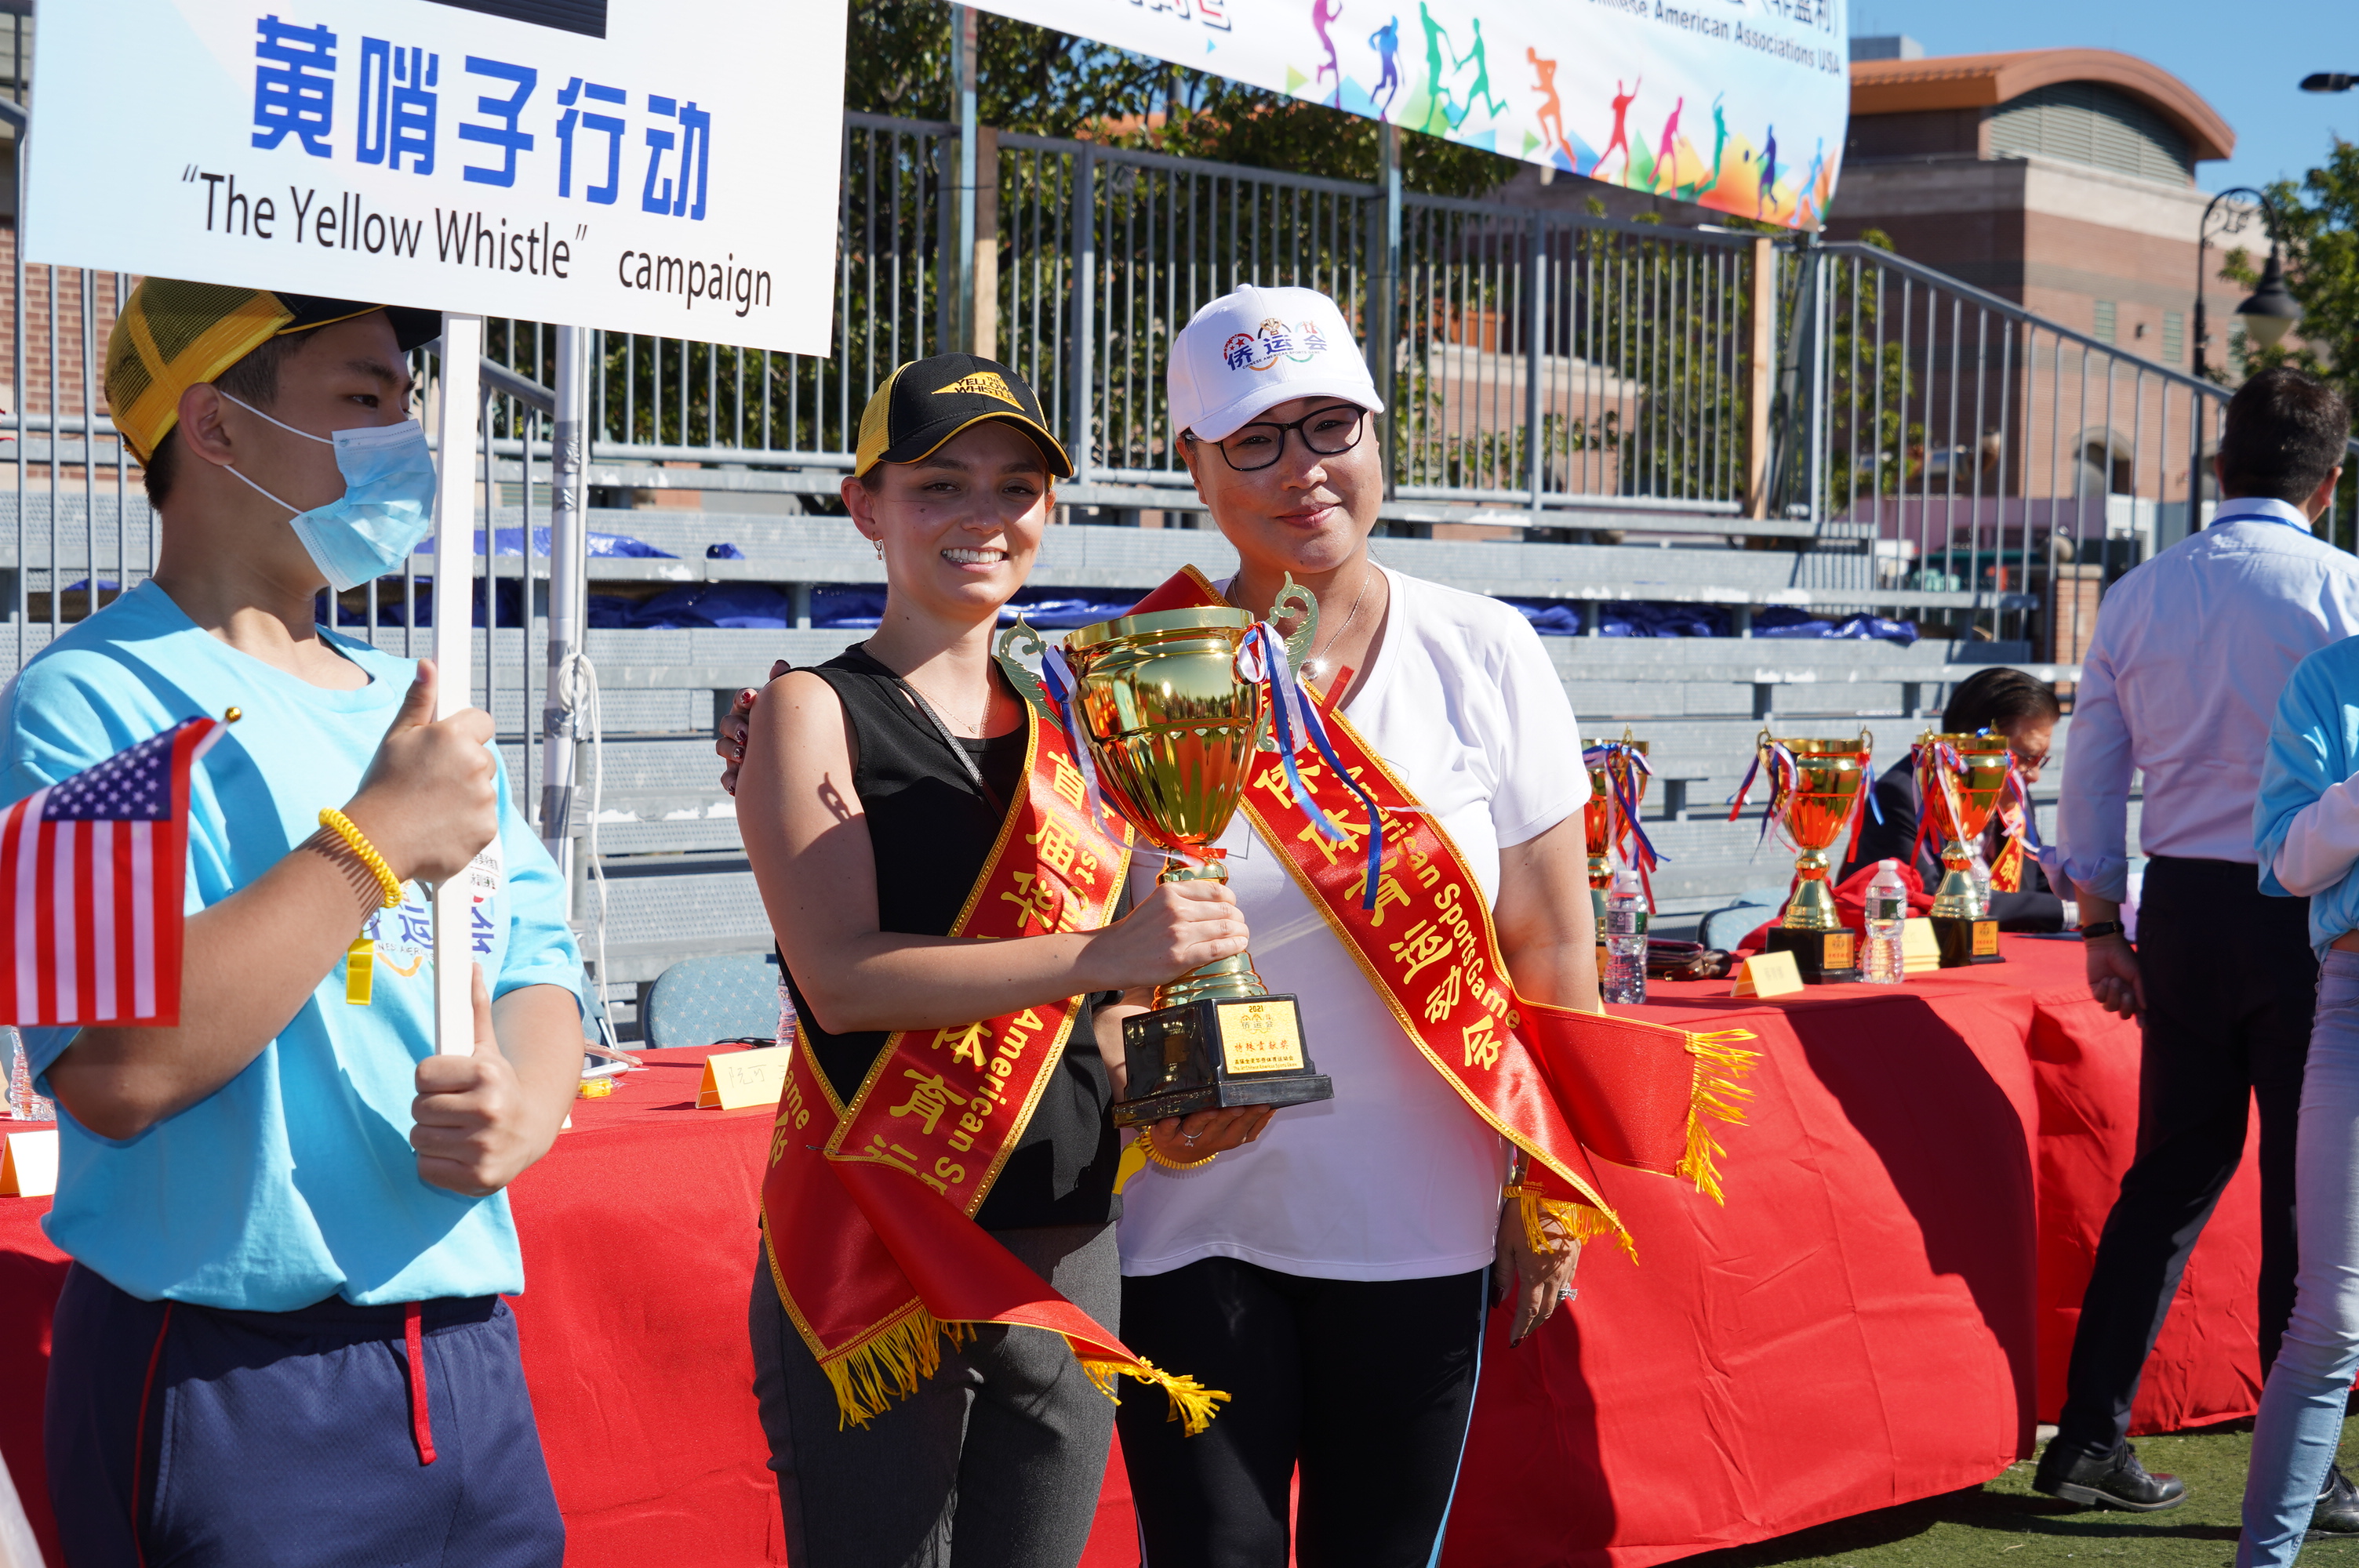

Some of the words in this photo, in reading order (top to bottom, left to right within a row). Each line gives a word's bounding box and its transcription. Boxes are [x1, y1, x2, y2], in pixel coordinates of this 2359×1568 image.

[1654, 0, 1729, 41] American
[1734, 20, 1815, 68] Associations
[1818, 48, 1841, 76] USA
[251, 15, 711, 222] 黄哨子行动
[289, 186, 424, 259] Yellow
[618, 249, 772, 318] campaign
[956, 378, 1010, 393] YELLOW
[1227, 334, 1328, 371] 侨运会
[1241, 358, 1263, 369] CHINESE
[1263, 350, 1289, 361] AMERICAN
[954, 385, 1016, 401] WHISTLE
[1434, 883, 1480, 966] Sports
[1466, 958, 1521, 1029] Game
[947, 1007, 1046, 1152] American
